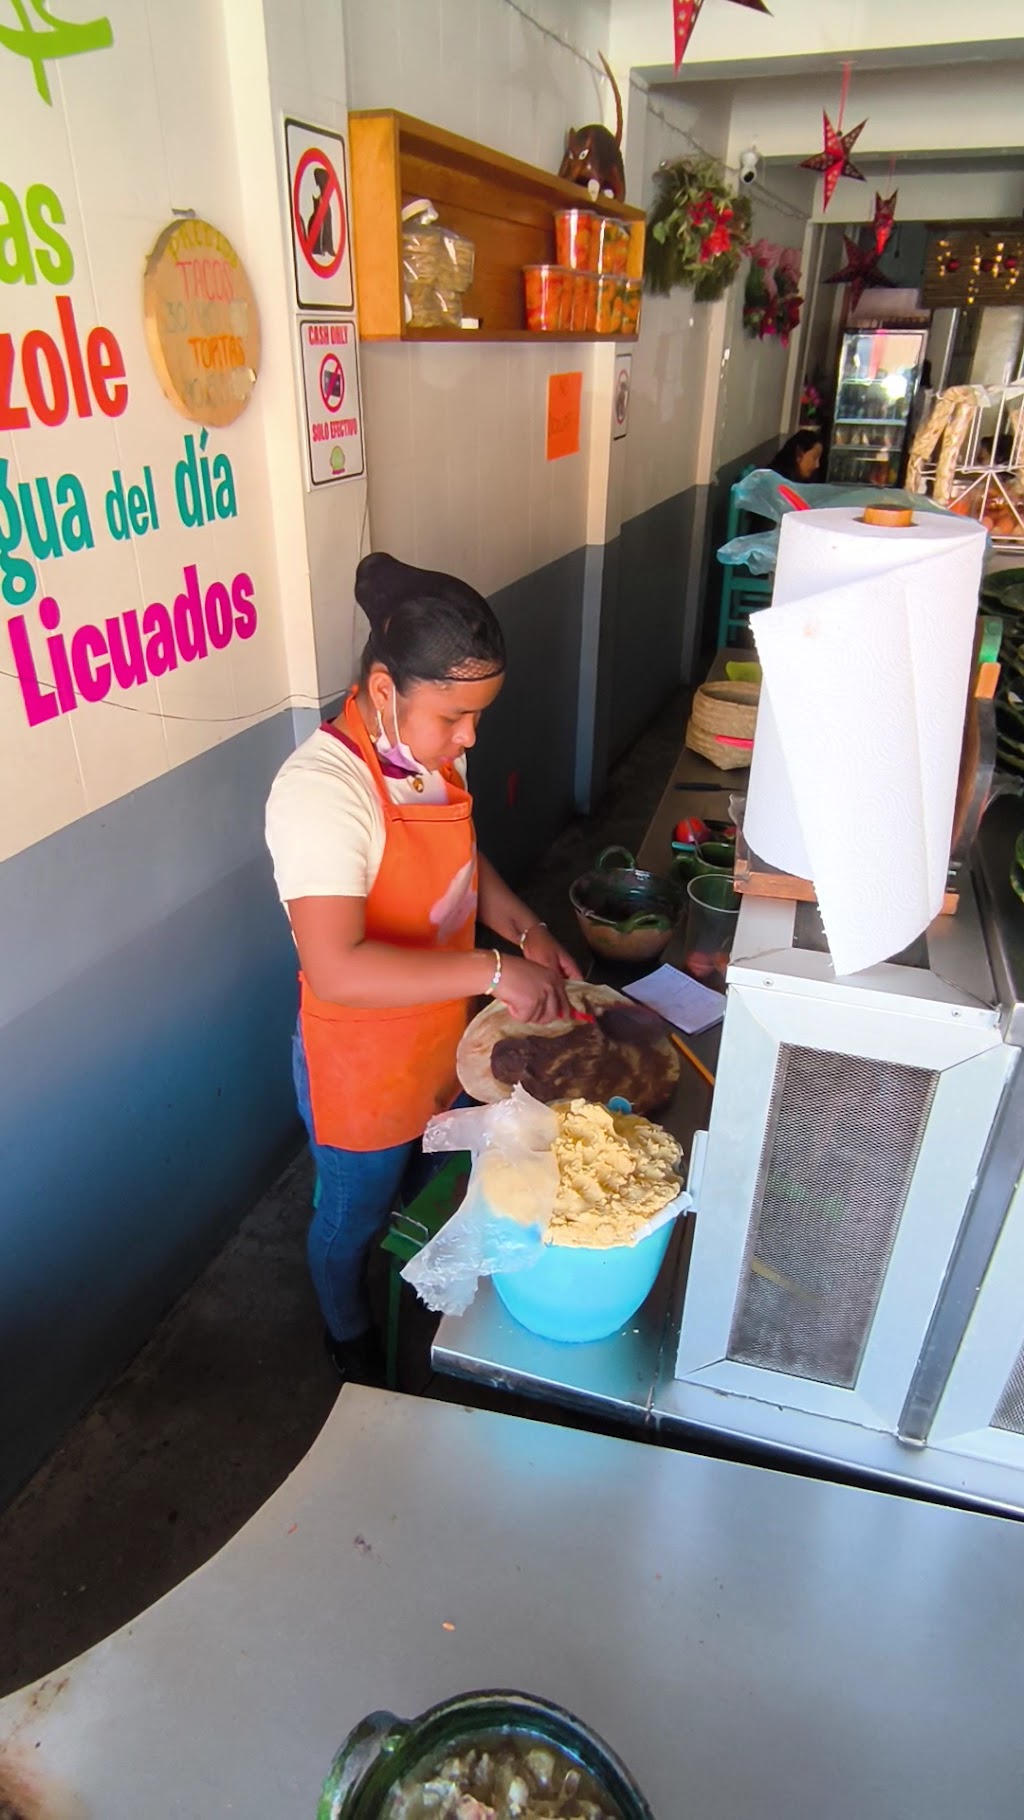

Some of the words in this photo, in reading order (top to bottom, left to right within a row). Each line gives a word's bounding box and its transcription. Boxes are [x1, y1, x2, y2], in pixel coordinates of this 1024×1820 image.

[175, 259, 234, 302] TACOS
[308, 325, 329, 345] CASH
[330, 325, 348, 344] ONLY
[312, 422, 330, 442] SOLO
[330, 417, 358, 439] EFECTIVO
[105, 466, 161, 540] del
[174, 428, 238, 528] día
[8, 564, 257, 727] Licuados
